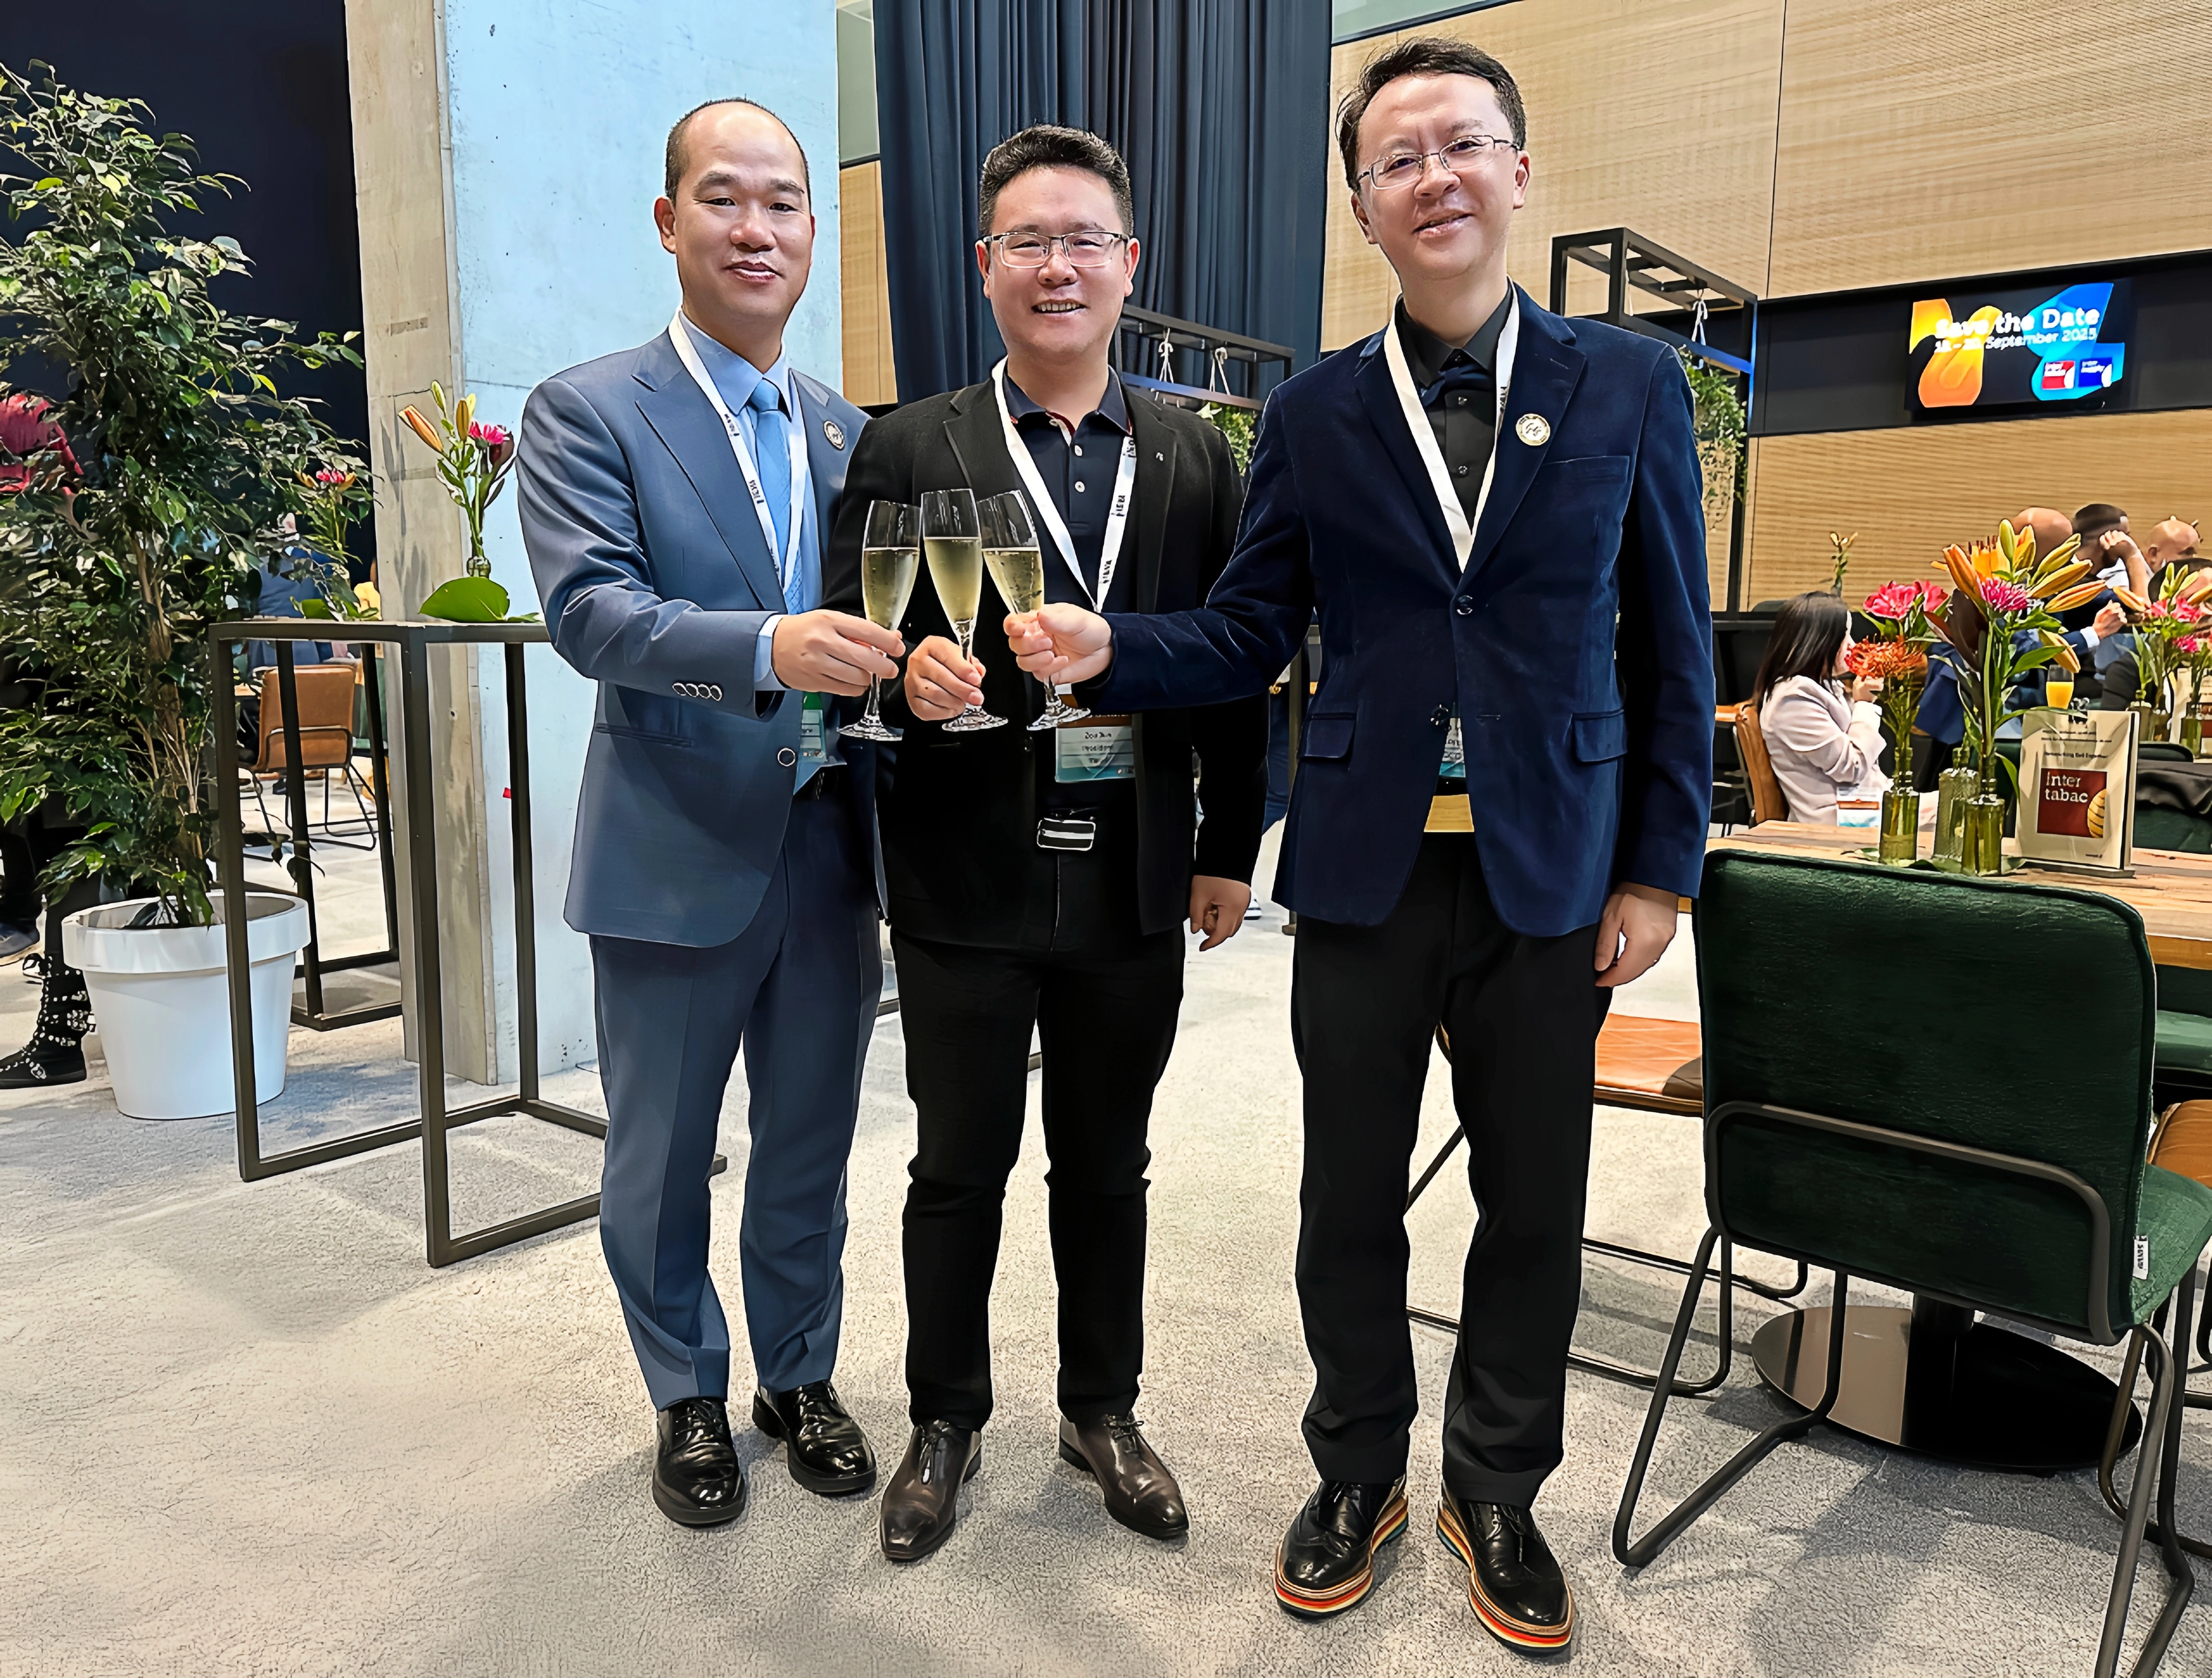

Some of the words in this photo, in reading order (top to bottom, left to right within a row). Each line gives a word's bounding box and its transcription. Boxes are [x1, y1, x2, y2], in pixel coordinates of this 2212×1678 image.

[1995, 312, 2034, 333] the
[2042, 308, 2100, 329] Date
[1986, 332, 2059, 350] September
[2061, 327, 2096, 342] 2025
[2046, 772, 2081, 788] Inter
[2045, 789, 2088, 803] tabac
